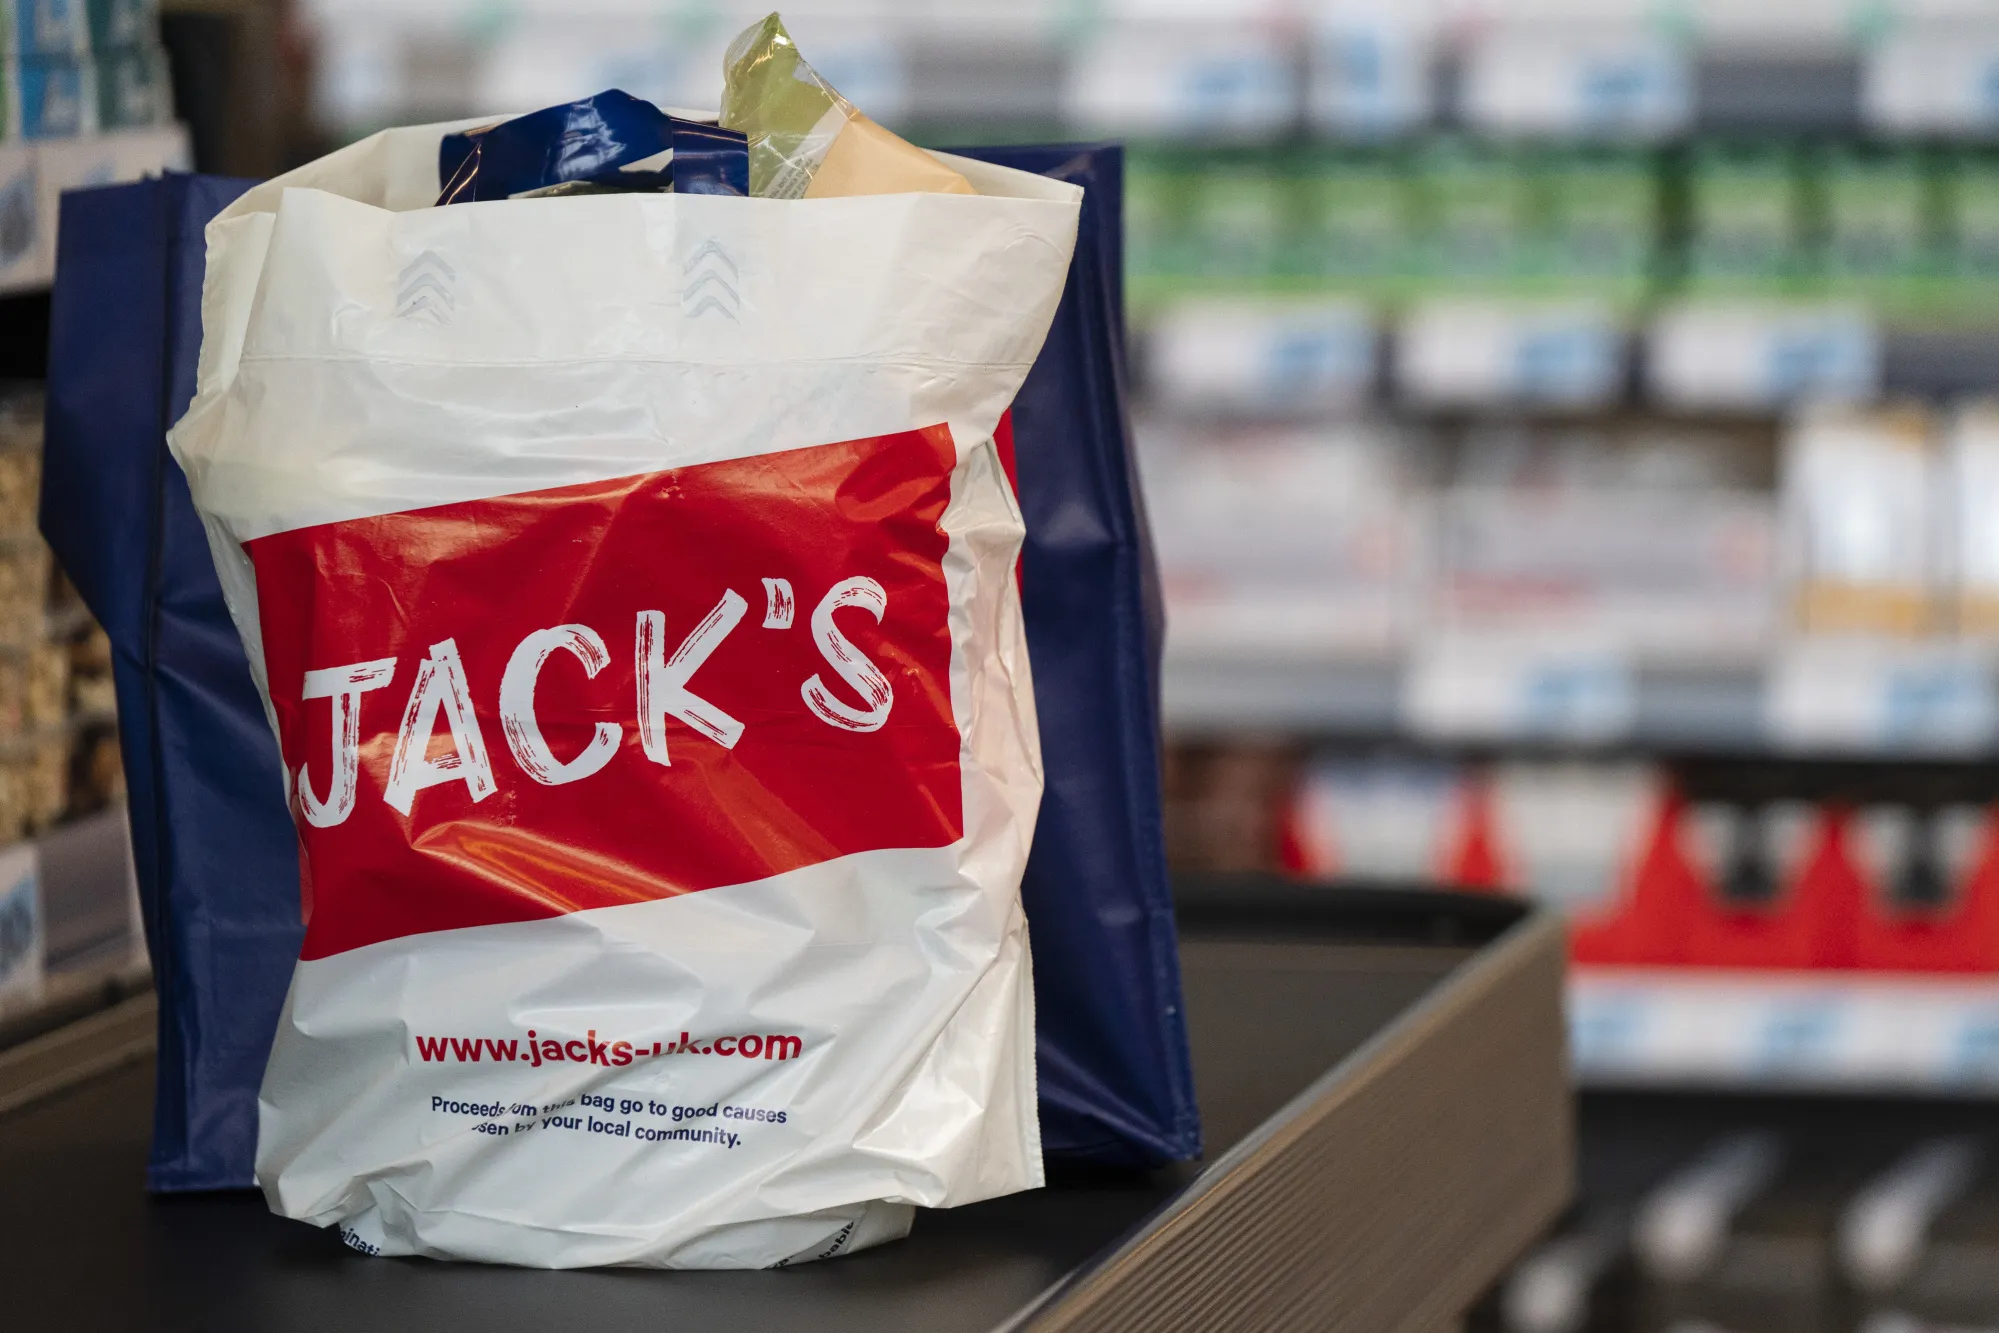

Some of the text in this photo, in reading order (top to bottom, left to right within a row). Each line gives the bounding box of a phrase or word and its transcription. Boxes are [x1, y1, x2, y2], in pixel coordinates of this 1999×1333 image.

[299, 576, 893, 828] JACK'S
[415, 1029, 803, 1067] www.jacks-uk.com
[431, 1096, 505, 1117] Proceeds
[542, 1098, 575, 1114] this
[580, 1093, 615, 1112] bag
[619, 1099, 644, 1115] go
[648, 1100, 667, 1116] to
[671, 1103, 719, 1122] good
[722, 1105, 788, 1124] causes
[514, 1121, 537, 1134] by
[541, 1116, 583, 1131] your
[587, 1115, 631, 1138] local
[634, 1126, 742, 1149] community.
